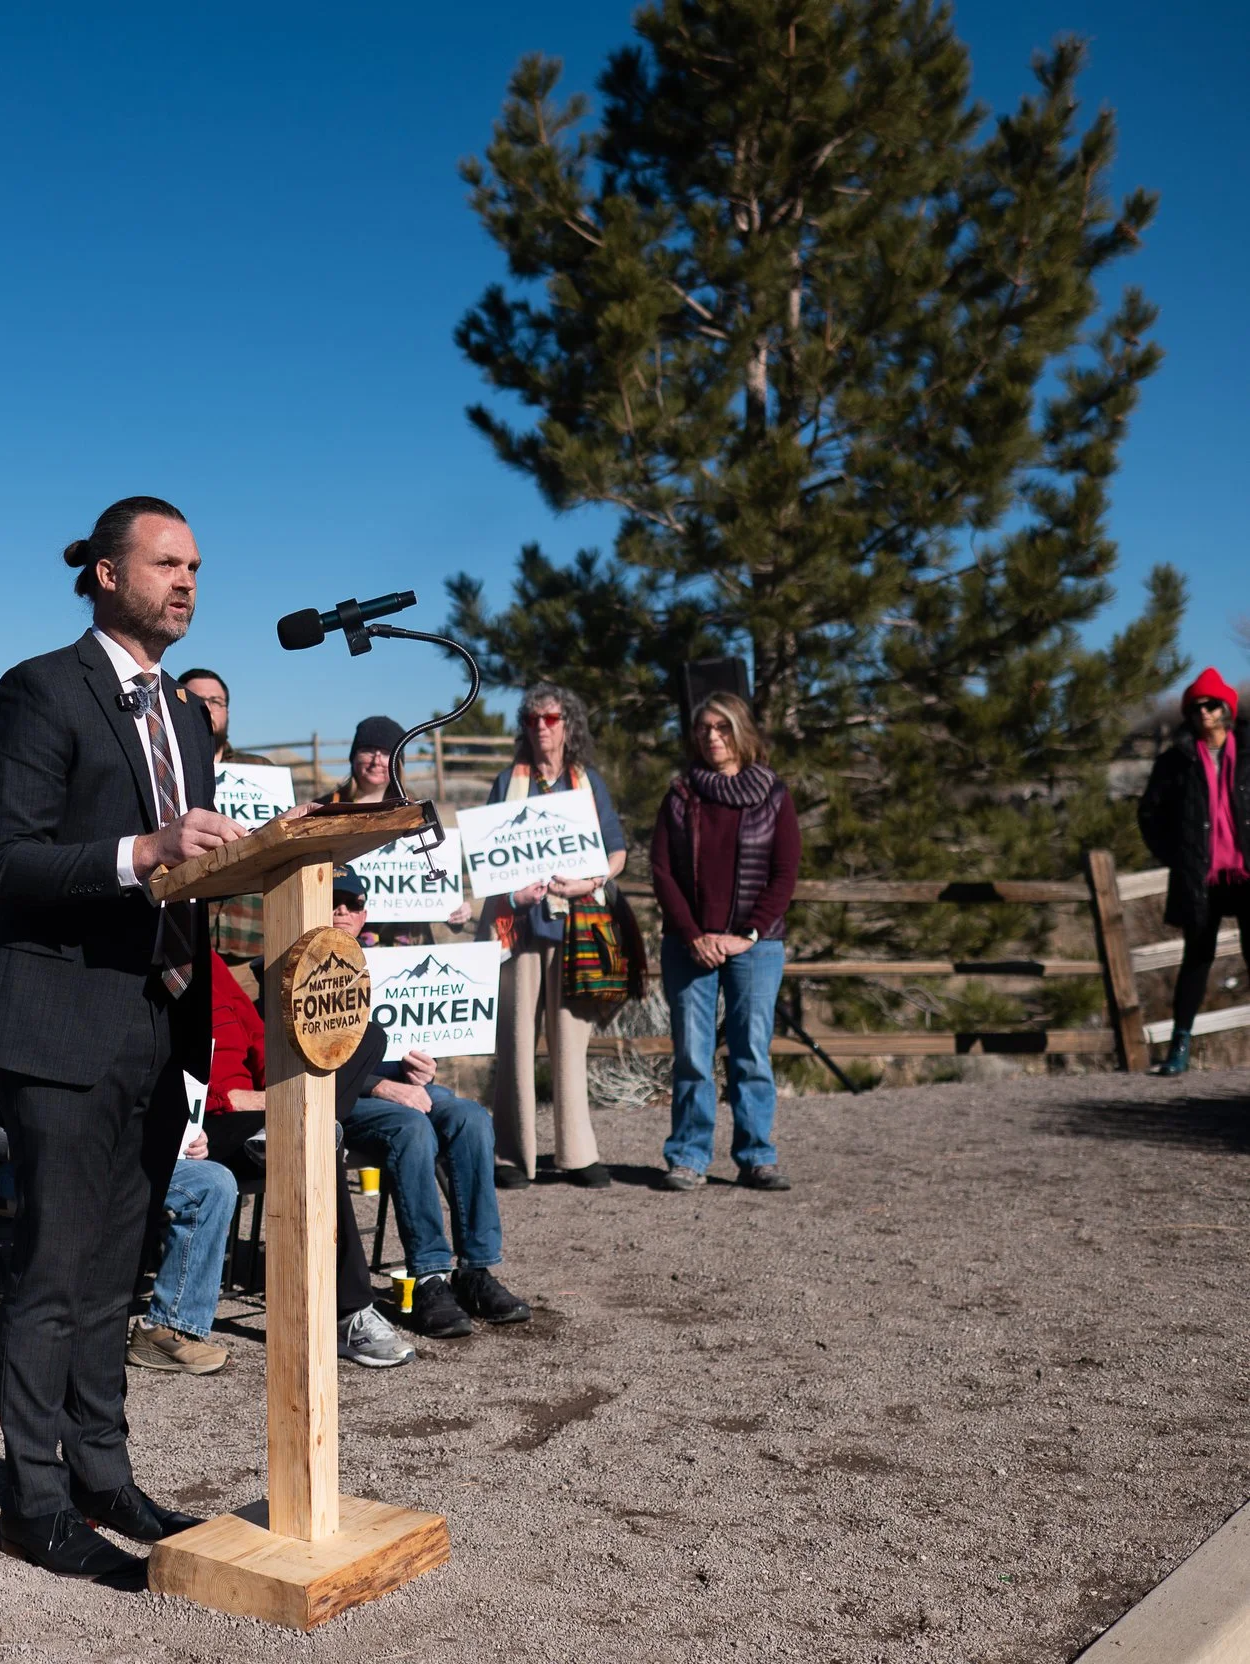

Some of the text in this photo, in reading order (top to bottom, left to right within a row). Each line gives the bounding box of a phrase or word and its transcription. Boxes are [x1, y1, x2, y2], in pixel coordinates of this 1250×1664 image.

[494, 823, 567, 845] MATTHEW
[469, 831, 601, 872] FONKEN
[359, 861, 431, 872] MATTHEW
[489, 856, 588, 882] FOR NEVADA
[384, 898, 445, 909] NEVADA
[309, 974, 354, 993] MATTHEW
[385, 983, 465, 1000] MATTHEW
[292, 986, 370, 1022] FONKEN
[302, 1013, 361, 1035] FOR NEVADA
[410, 1027, 475, 1044] NEVADA
